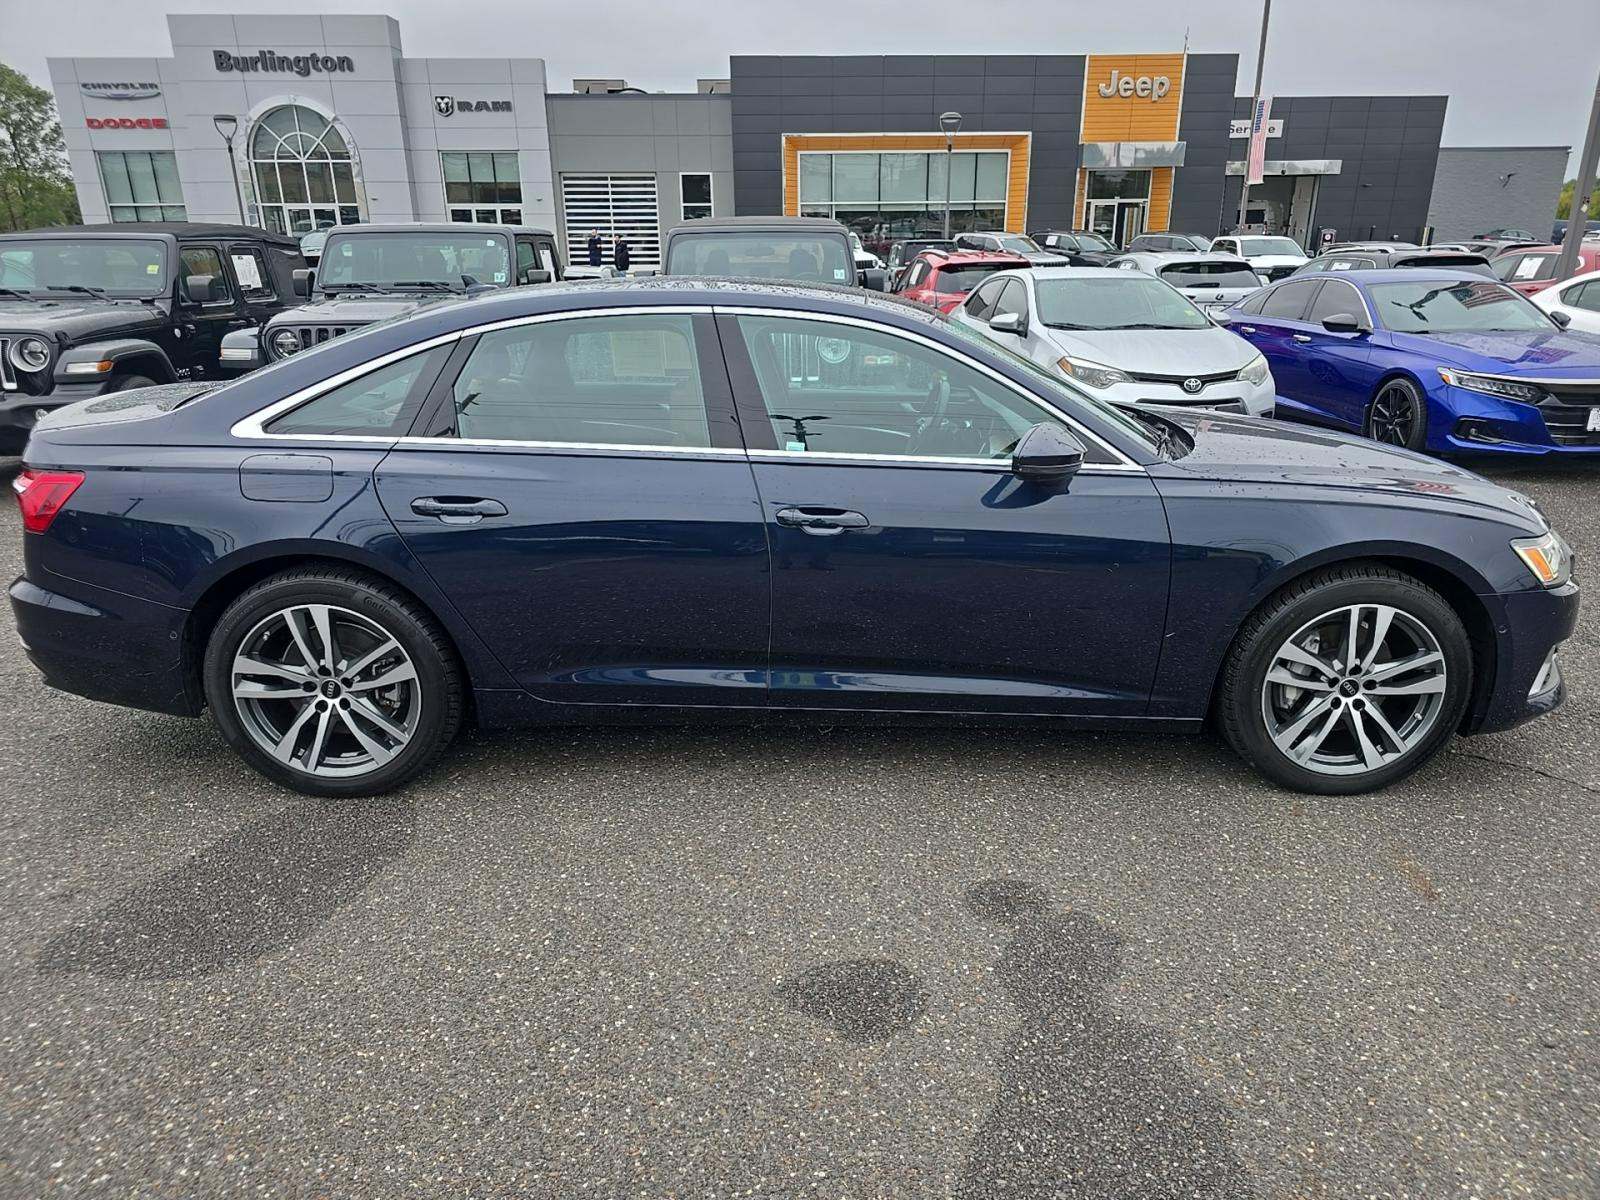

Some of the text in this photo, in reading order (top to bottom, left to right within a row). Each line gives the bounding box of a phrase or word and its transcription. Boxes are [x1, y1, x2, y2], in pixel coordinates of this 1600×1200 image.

[213, 50, 354, 77] Burlington
[81, 82, 159, 90] CHRYSLER
[1098, 70, 1171, 102] Jeep
[457, 101, 512, 112] RAM
[86, 118, 167, 129] DODGE
[1230, 124, 1275, 134] Sere
